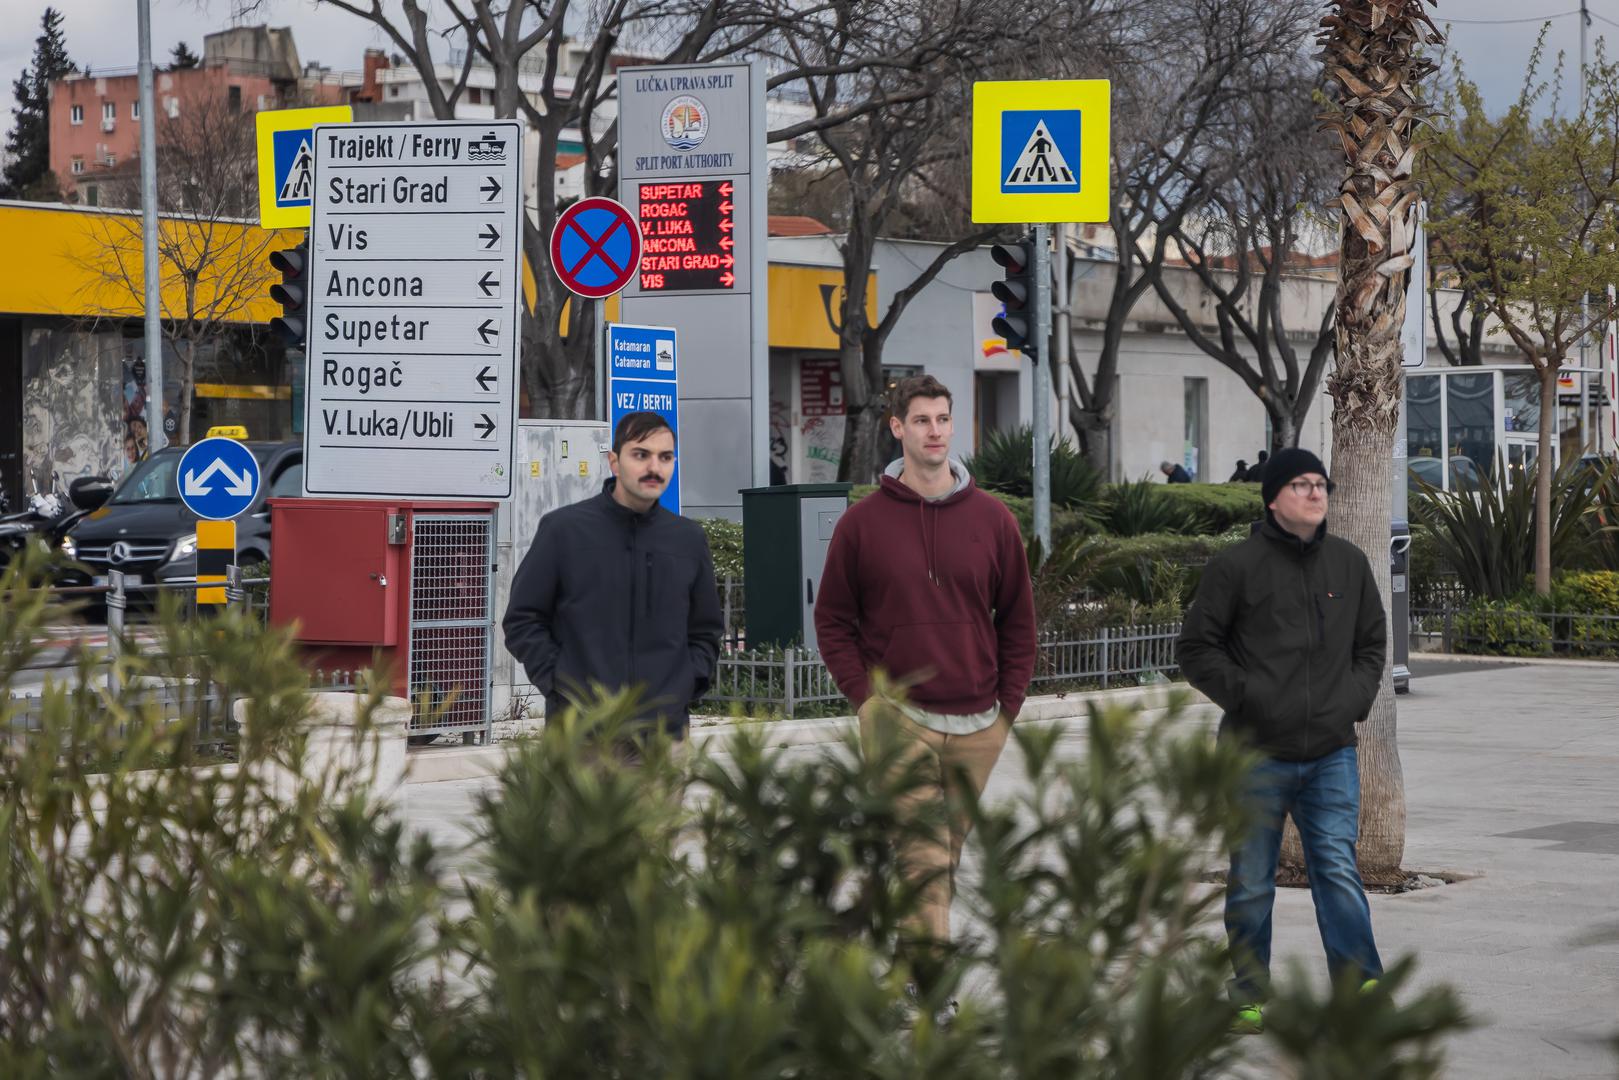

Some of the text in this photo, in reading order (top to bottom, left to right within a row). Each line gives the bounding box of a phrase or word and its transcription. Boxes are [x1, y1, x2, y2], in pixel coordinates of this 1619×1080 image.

[636, 74, 734, 93] LUČKA UPRAVA SPLIT
[328, 134, 461, 161] Trajekt / Ferry
[635, 153, 734, 171] SPLIT PORT AUTHORITY
[329, 176, 448, 204] Stari Grad
[640, 184, 702, 200] SUPETAR
[640, 202, 688, 218] ROGAC
[328, 223, 368, 251] Vis
[641, 220, 693, 236] V. LUKA
[642, 238, 696, 253] ANCONA
[641, 254, 720, 271] STARI GRAD
[326, 270, 423, 297] Ancona
[640, 274, 665, 289] VIS
[324, 313, 430, 347] Supetar
[614, 338, 651, 353] Katamaran
[614, 355, 651, 369] Catamaran
[323, 359, 403, 394] Rogač
[616, 392, 672, 411] VEZ / BERTH
[322, 409, 453, 441] V.Luka/Ubli
